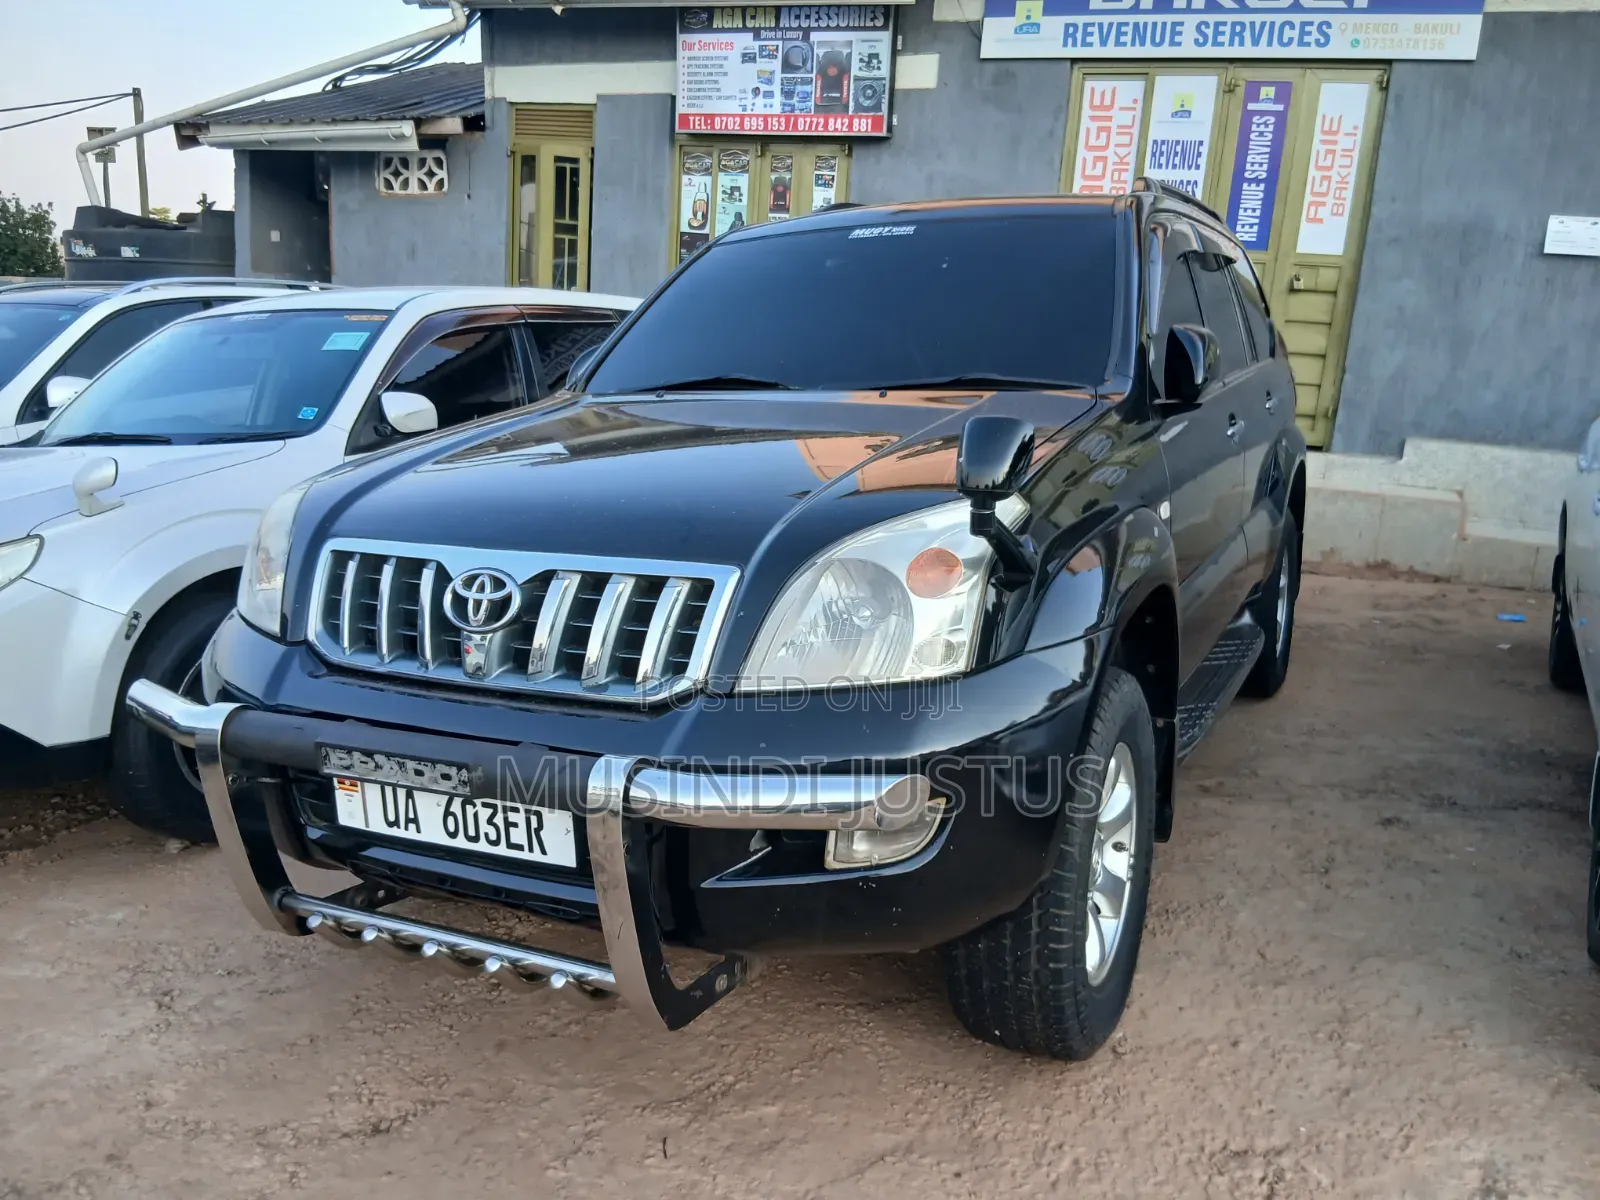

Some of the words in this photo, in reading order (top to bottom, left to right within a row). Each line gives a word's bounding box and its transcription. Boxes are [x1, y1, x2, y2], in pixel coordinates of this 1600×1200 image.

[713, 7, 743, 29] AGA
[745, 7, 776, 28] CAR
[779, 6, 885, 28] ACCESSORIES
[1016, 26, 1039, 34] URA
[1351, 22, 1399, 35] MENGO
[1413, 22, 1461, 35] BAKULI
[681, 40, 696, 52] Our
[697, 39, 735, 51] Services
[760, 29, 776, 39] Drive
[783, 29, 804, 41] Luxury
[1062, 21, 1183, 48] REVENUE
[1193, 20, 1333, 48] SERVICES
[688, 116, 711, 130] TEL:
[714, 116, 741, 130] 0702
[743, 117, 764, 131] 695
[767, 117, 786, 131] 153
[789, 118, 794, 131] /
[797, 117, 824, 132] 0772
[827, 118, 849, 132] 842
[852, 118, 872, 132] 881
[1149, 139, 1204, 171] REVENUE
[1244, 115, 1276, 180] SERVICES
[1305, 113, 1343, 225] AGGIE
[1235, 183, 1265, 242] REVENUE
[381, 785, 421, 834] UA
[442, 795, 548, 856] 603ER
